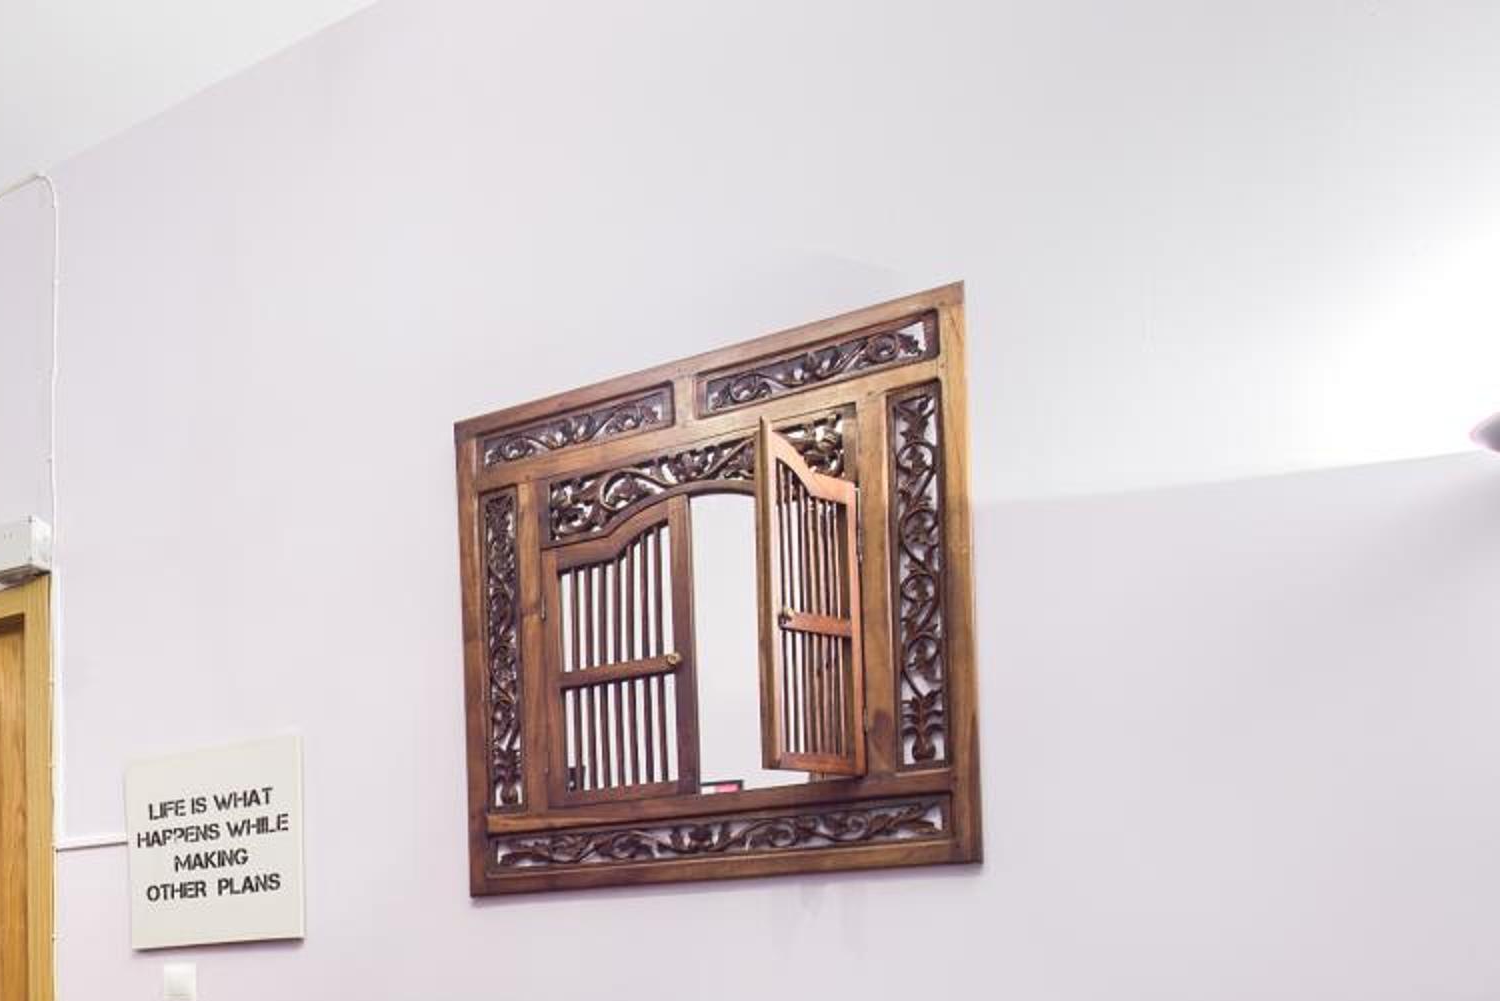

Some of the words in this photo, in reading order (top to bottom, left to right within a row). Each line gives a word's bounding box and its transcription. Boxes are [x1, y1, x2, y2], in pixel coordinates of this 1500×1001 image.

[148, 799, 187, 820] LIFE
[191, 797, 207, 815] IS
[213, 787, 273, 811] WHAT
[136, 823, 220, 848] HAPPENS
[226, 813, 289, 837] WHILE
[174, 848, 248, 872] MAKING
[146, 880, 207, 902] OTHER
[217, 873, 281, 896] PLANS
